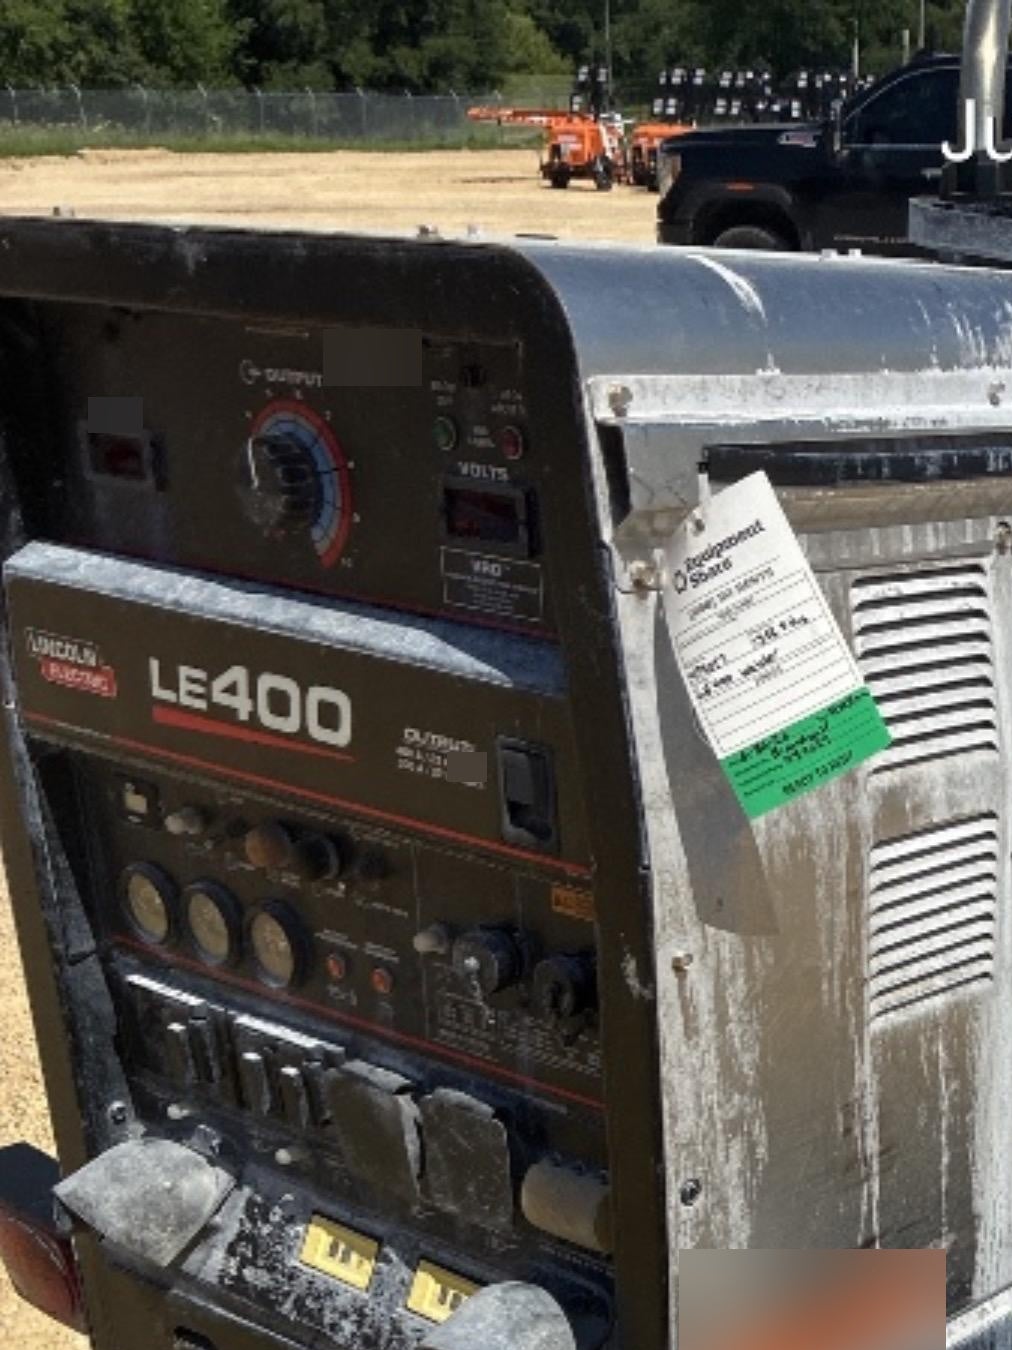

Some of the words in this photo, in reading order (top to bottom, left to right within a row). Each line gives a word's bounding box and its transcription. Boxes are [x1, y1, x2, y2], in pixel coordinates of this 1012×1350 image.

[457, 461, 509, 482] VOLTS
[30, 634, 98, 667] LINCOLN
[148, 655, 353, 749] LE400
